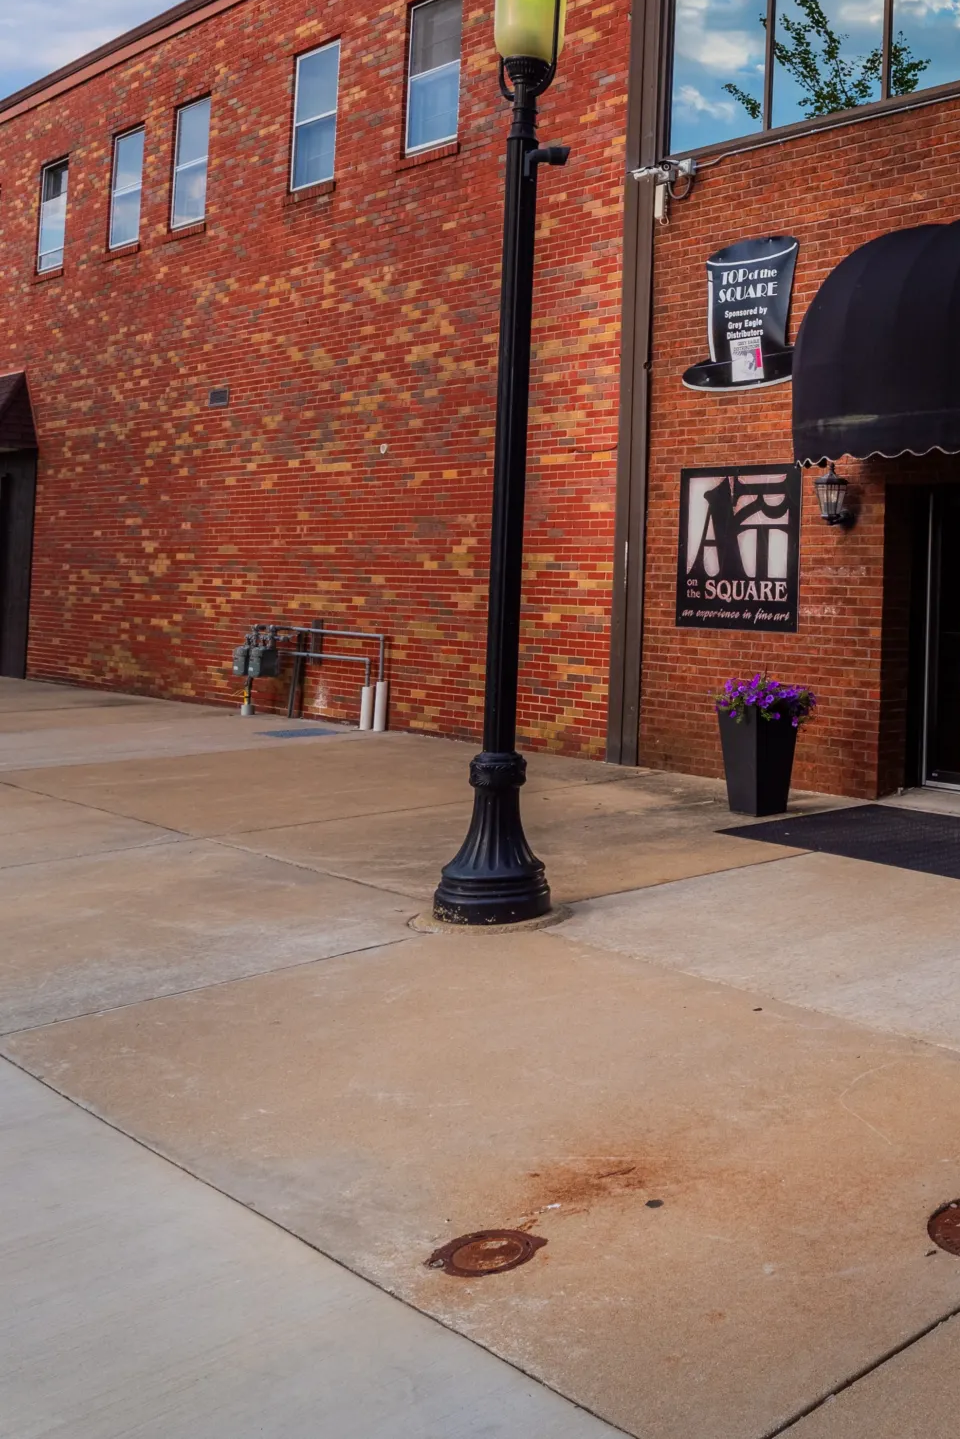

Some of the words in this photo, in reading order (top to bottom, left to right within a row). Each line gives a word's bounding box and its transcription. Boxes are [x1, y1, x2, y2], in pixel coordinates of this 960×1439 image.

[720, 268, 749, 286] TOP
[749, 270, 759, 280] of
[760, 268, 778, 279] the
[718, 281, 778, 303] SQUARE
[724, 308, 757, 319] Sponsored
[758, 306, 768, 317] by
[727, 321, 743, 331] Grey
[744, 318, 763, 329] Eagle
[726, 329, 764, 340] Distributors
[686, 579, 699, 587] on
[686, 589, 701, 599] the
[704, 580, 788, 603] SQUARE
[682, 609, 694, 617] an
[695, 608, 741, 622] experience
[743, 609, 752, 619] in
[753, 608, 773, 624] fine
[773, 611, 790, 622] art
